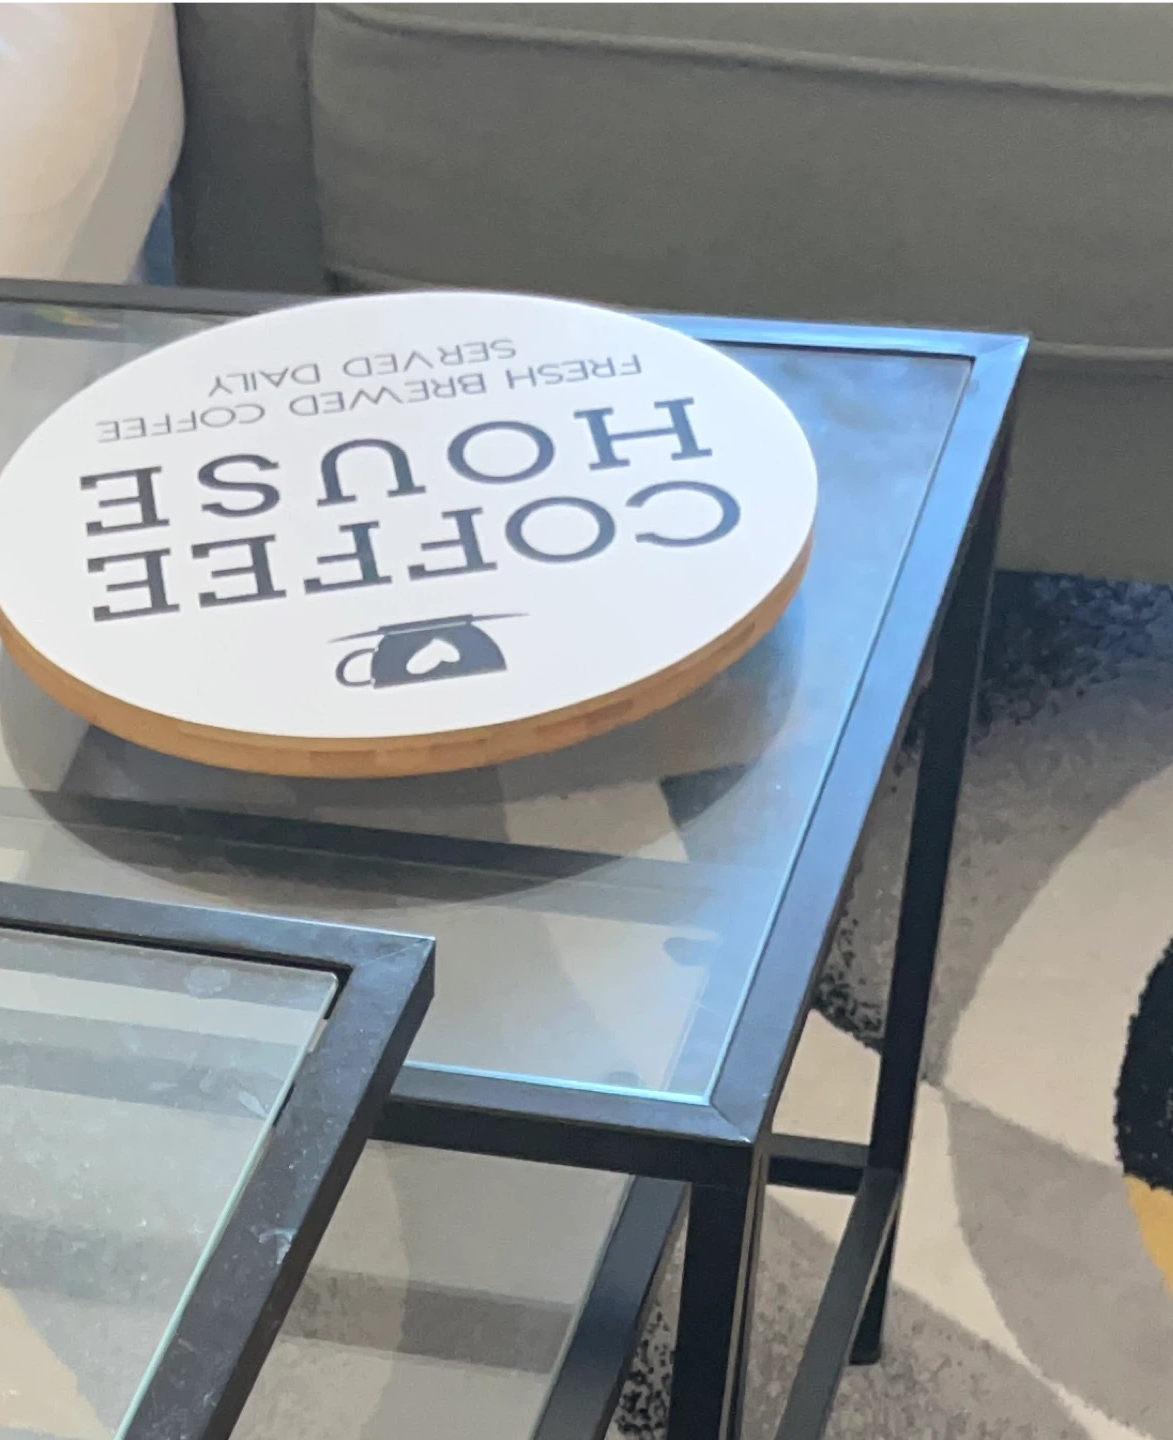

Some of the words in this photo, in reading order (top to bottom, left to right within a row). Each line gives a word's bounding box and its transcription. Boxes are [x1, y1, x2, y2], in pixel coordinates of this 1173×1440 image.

[342, 338, 517, 378] SERVED
[505, 353, 643, 390] FRESH
[208, 362, 322, 398] DAILY
[289, 371, 488, 417] BREWED
[96, 403, 266, 444] COFFEE
[79, 396, 714, 545] HOUSE
[86, 479, 742, 623] COFFEE
